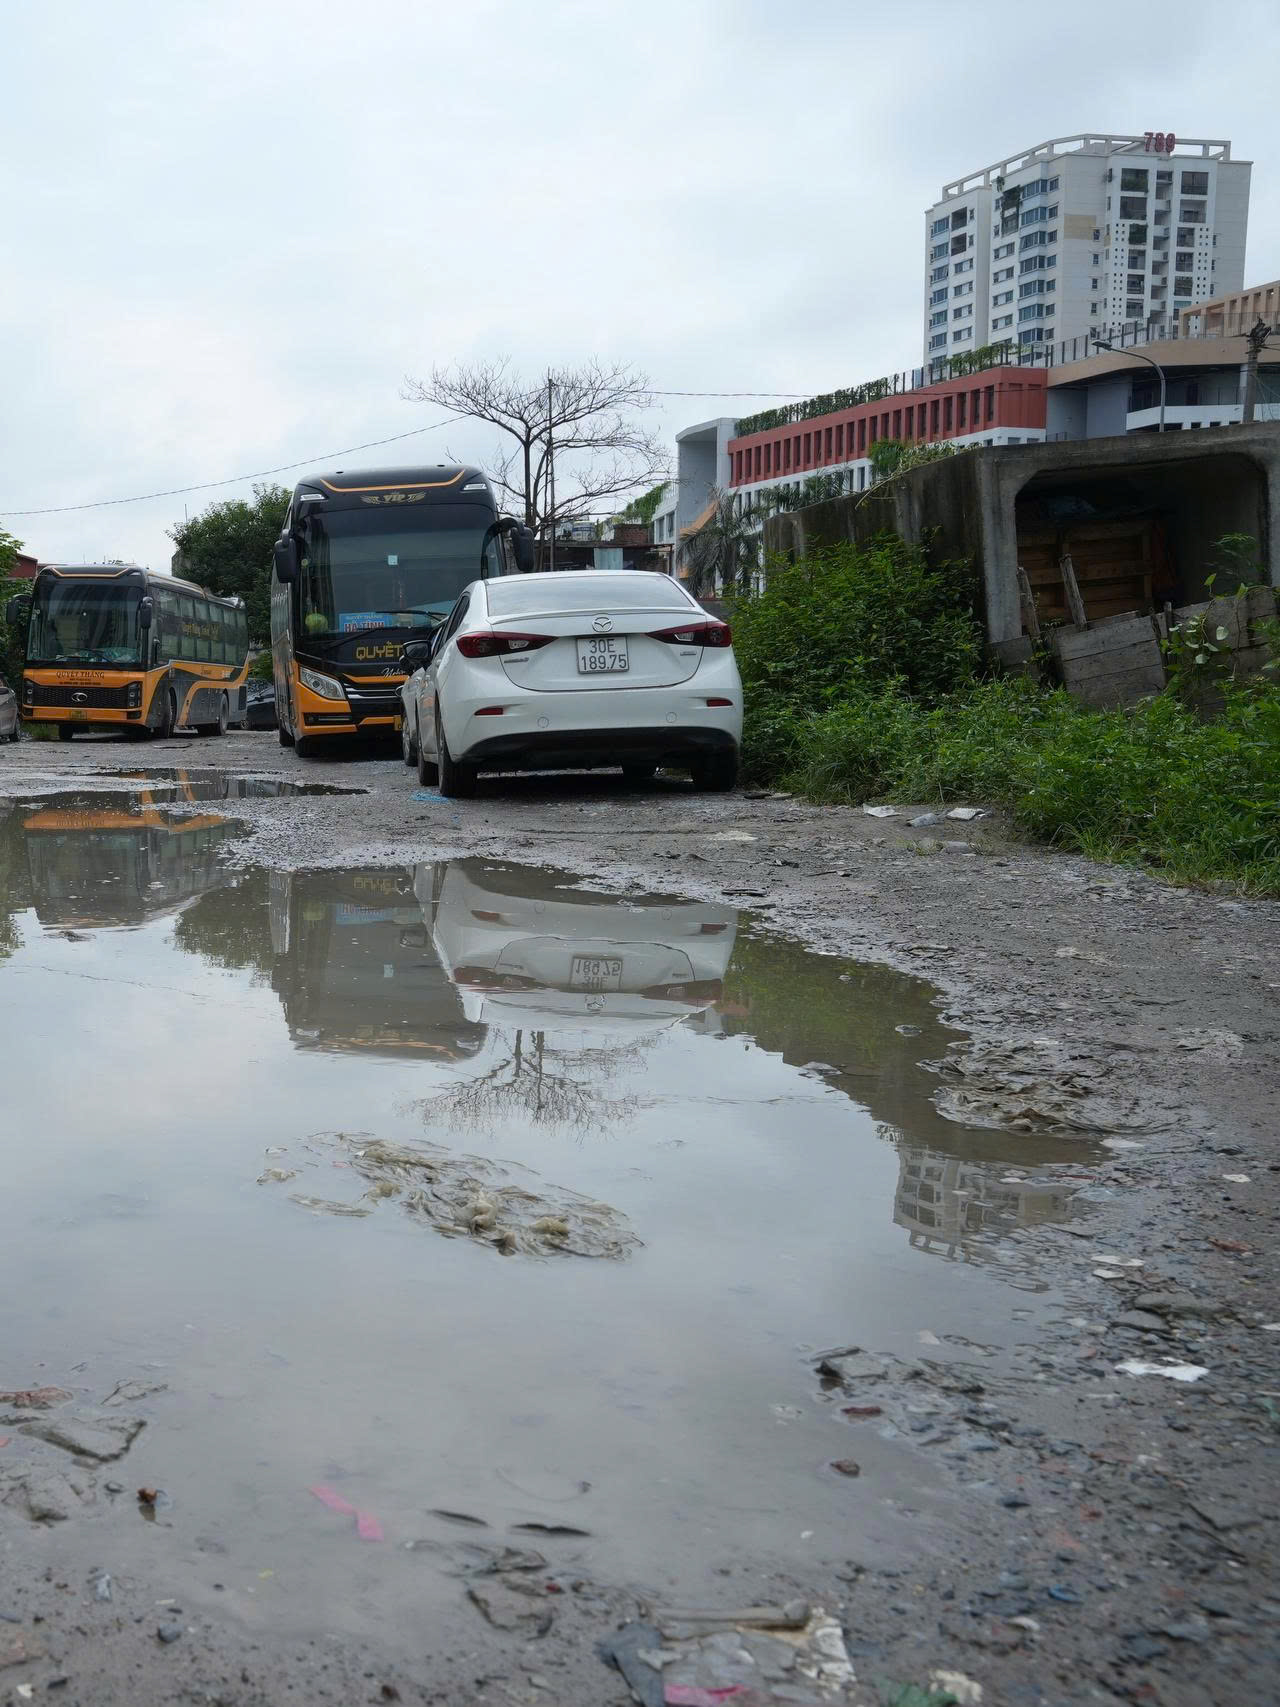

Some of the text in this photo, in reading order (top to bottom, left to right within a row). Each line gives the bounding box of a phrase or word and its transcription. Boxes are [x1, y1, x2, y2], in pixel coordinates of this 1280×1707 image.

[1144, 131, 1176, 153] 789
[589, 638, 616, 654] 30E
[581, 654, 627, 670] 189.75
